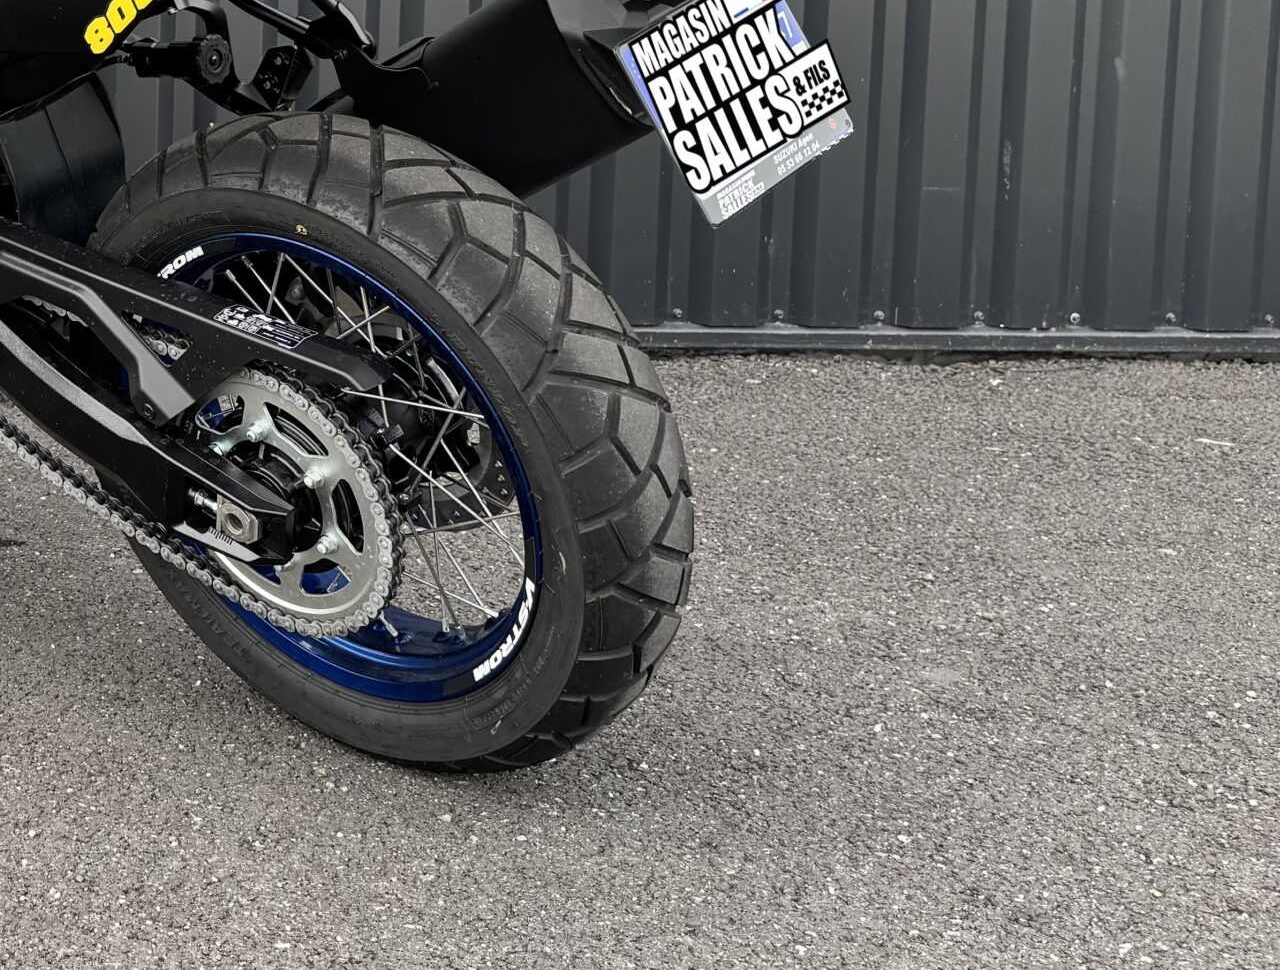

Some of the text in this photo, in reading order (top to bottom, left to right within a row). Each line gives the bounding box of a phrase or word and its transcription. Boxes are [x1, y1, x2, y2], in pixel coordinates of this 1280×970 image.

[773, 132, 814, 165] SUZUKI Agen
[777, 166, 786, 176] 05
[785, 159, 795, 170] 53
[803, 147, 812, 158] 12
[719, 179, 755, 211] PATRICK
[721, 189, 754, 220] SALLES
[472, 577, 536, 684] V-STROM
